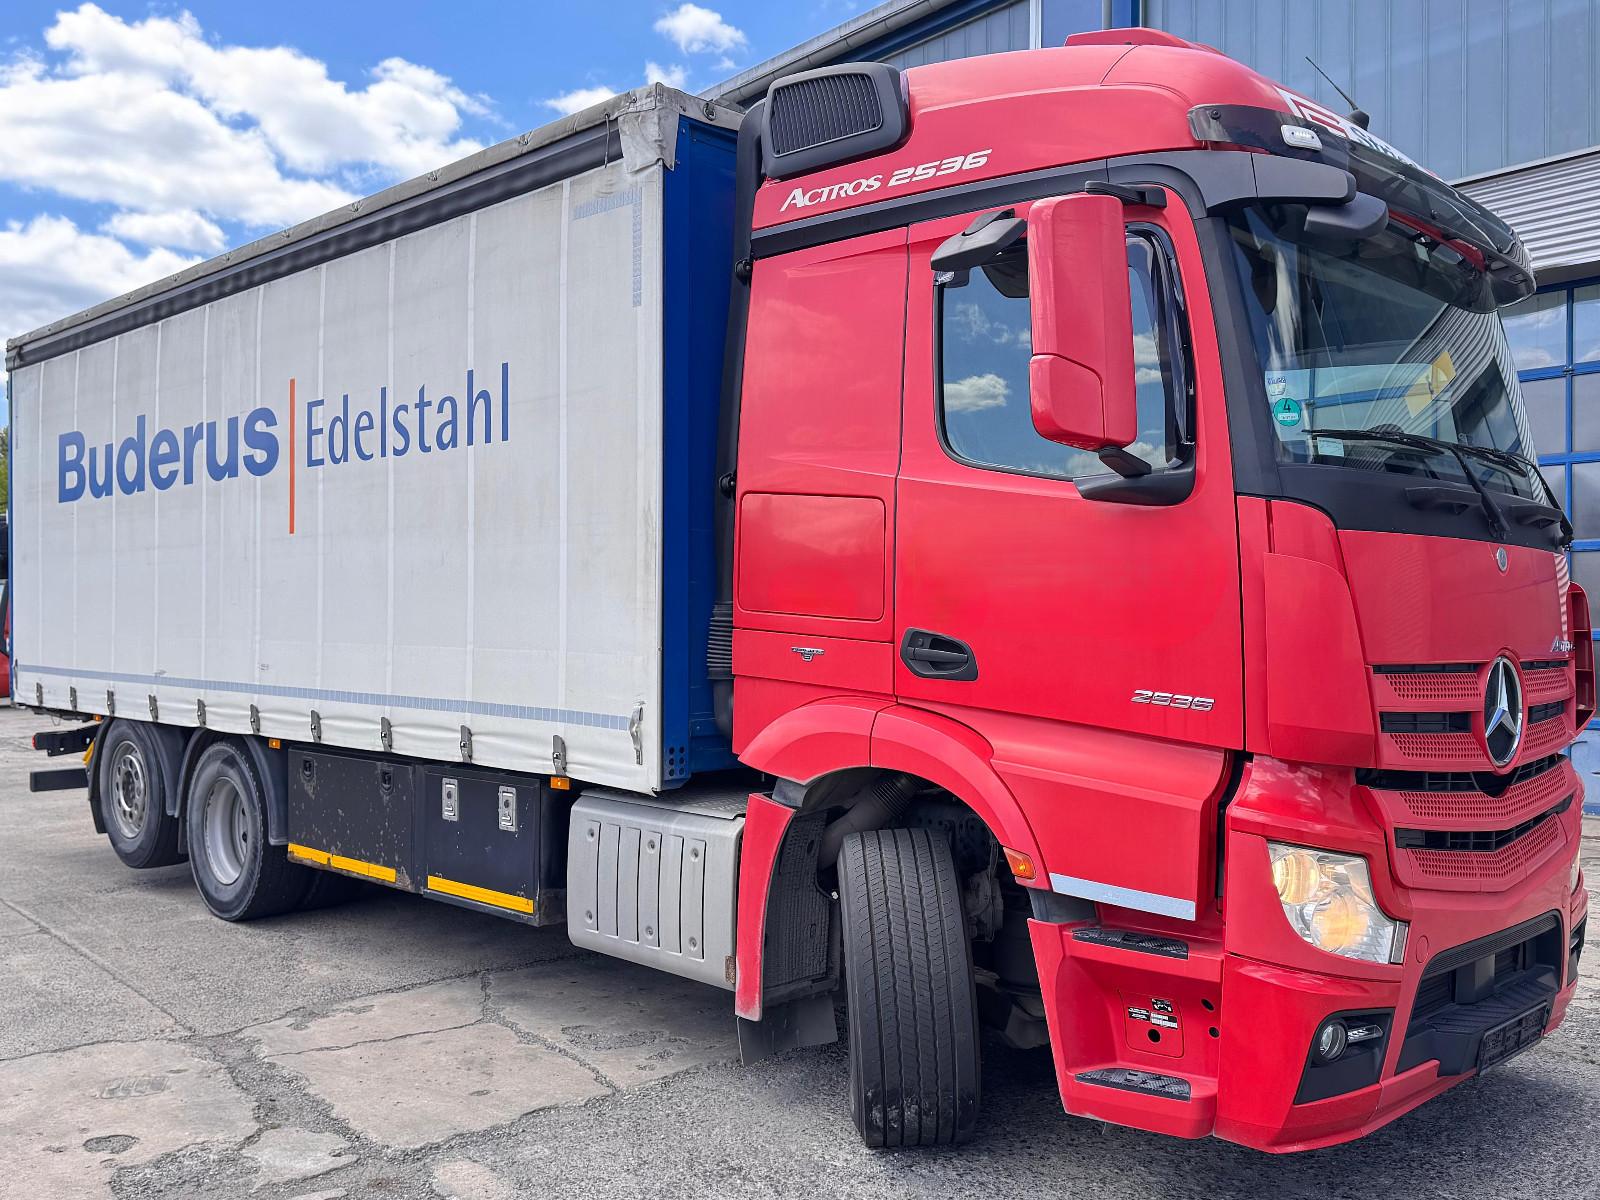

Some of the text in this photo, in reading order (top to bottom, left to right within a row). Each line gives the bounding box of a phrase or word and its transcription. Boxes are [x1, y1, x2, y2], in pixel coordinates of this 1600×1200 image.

[780, 148, 993, 213] ACTROS 2536
[1283, 398, 1292, 413] 4
[58, 361, 509, 504] Buderus Edelstahl
[1130, 689, 1216, 712] 2536
